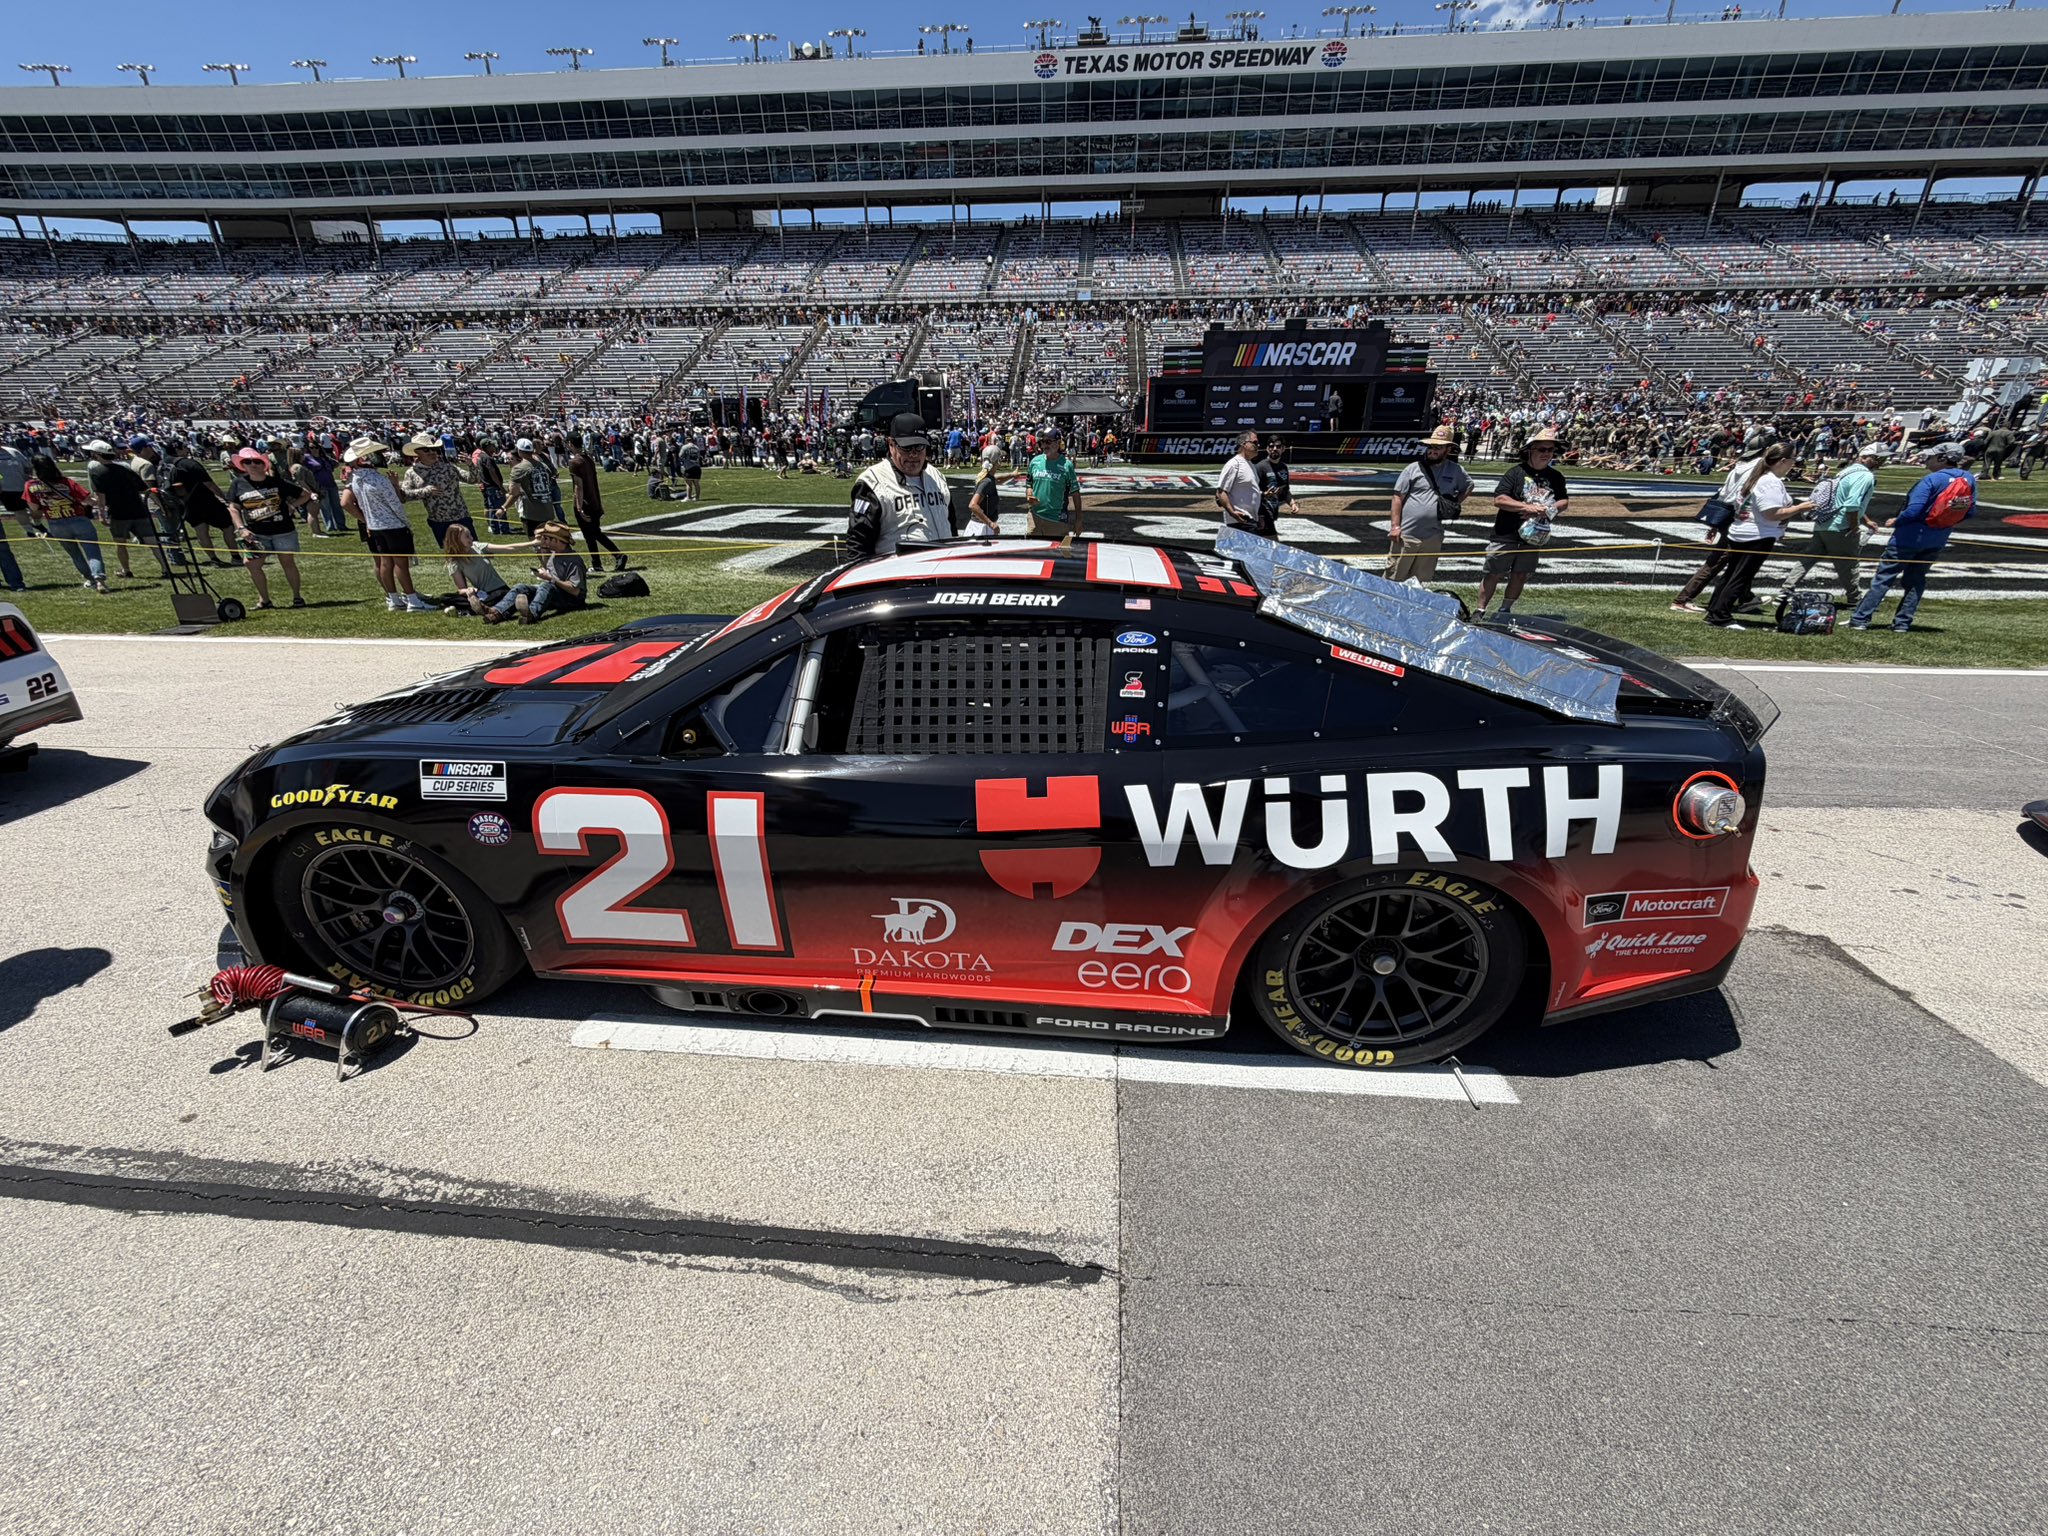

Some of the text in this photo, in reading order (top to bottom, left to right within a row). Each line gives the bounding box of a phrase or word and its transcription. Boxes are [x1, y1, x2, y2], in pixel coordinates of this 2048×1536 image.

[1064, 46, 1317, 74] TEXAS MOTOR SPEEDWAY
[1262, 342, 1357, 367] NASCAR
[927, 592, 1065, 607] JOSH BERRY
[1338, 648, 1397, 672] WELDERS
[26, 672, 59, 702] 22
[1111, 721, 1151, 735] WBR
[447, 763, 493, 776] NASCAR
[432, 780, 495, 793] CUP SERIES
[271, 785, 398, 810] GOODYEAR
[473, 815, 505, 826] NASCAR
[314, 828, 395, 848] EAGLE
[475, 833, 508, 844] SALUTES
[531, 786, 785, 951] 21
[1405, 871, 1499, 915] EAGLE
[1632, 896, 1717, 913] Motorcraft
[1051, 921, 1196, 958] DEX
[1605, 931, 1708, 951] Quick Lane
[851, 947, 994, 972] DAKOTA
[1615, 949, 1632, 957] TIRE
[1639, 947, 1662, 955] AUTO
[1662, 946, 1696, 954] CENTER
[857, 968, 991, 983] PREMIUM HARDWOODS
[1078, 960, 1192, 994] eero
[1036, 1016, 1216, 1036] FORD RACING
[1266, 969, 1395, 1066] GOODYEAR
[292, 1021, 327, 1041] WBR
[365, 1021, 389, 1044] 21
